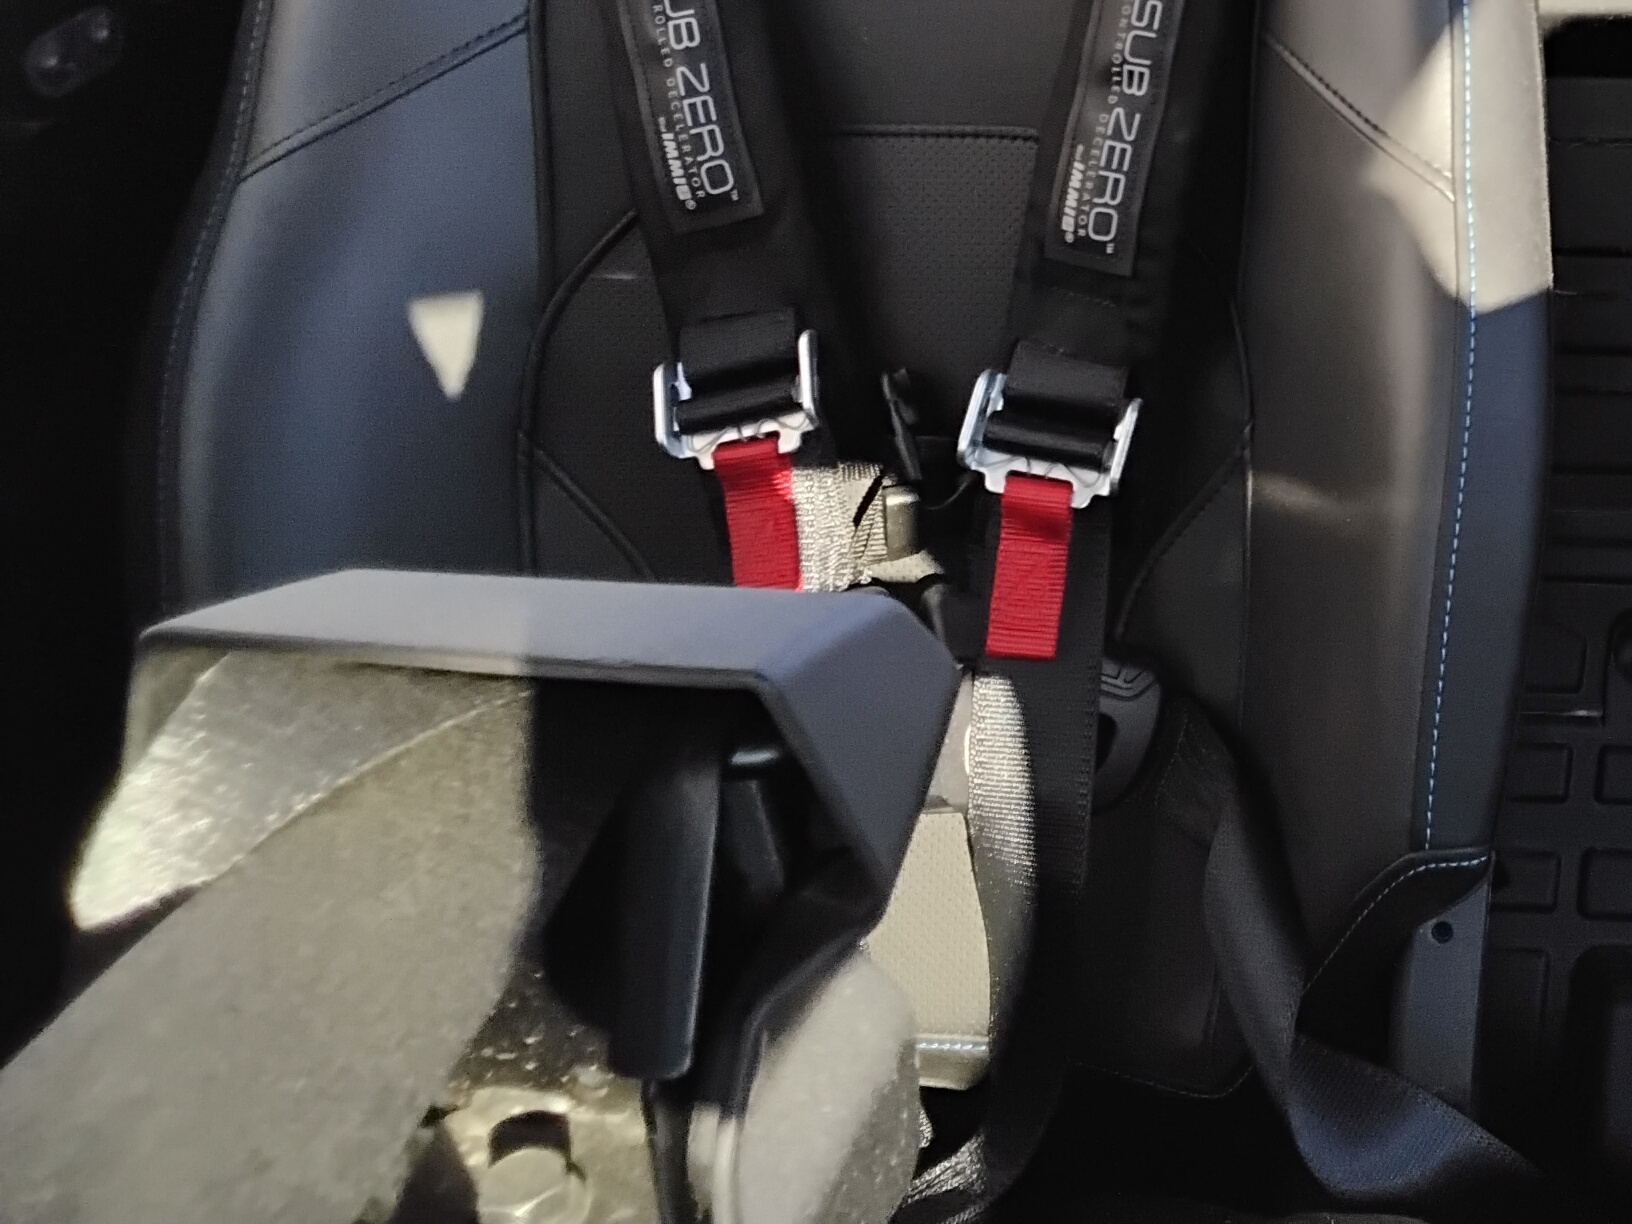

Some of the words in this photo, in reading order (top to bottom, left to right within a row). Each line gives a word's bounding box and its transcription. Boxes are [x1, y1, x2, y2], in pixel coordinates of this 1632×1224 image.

[667, 78, 705, 198] DECELERATOR
[676, 63, 734, 195] ZERO
[1077, 113, 1109, 237] DECELERATOR
[1088, 107, 1141, 242] ZERO
